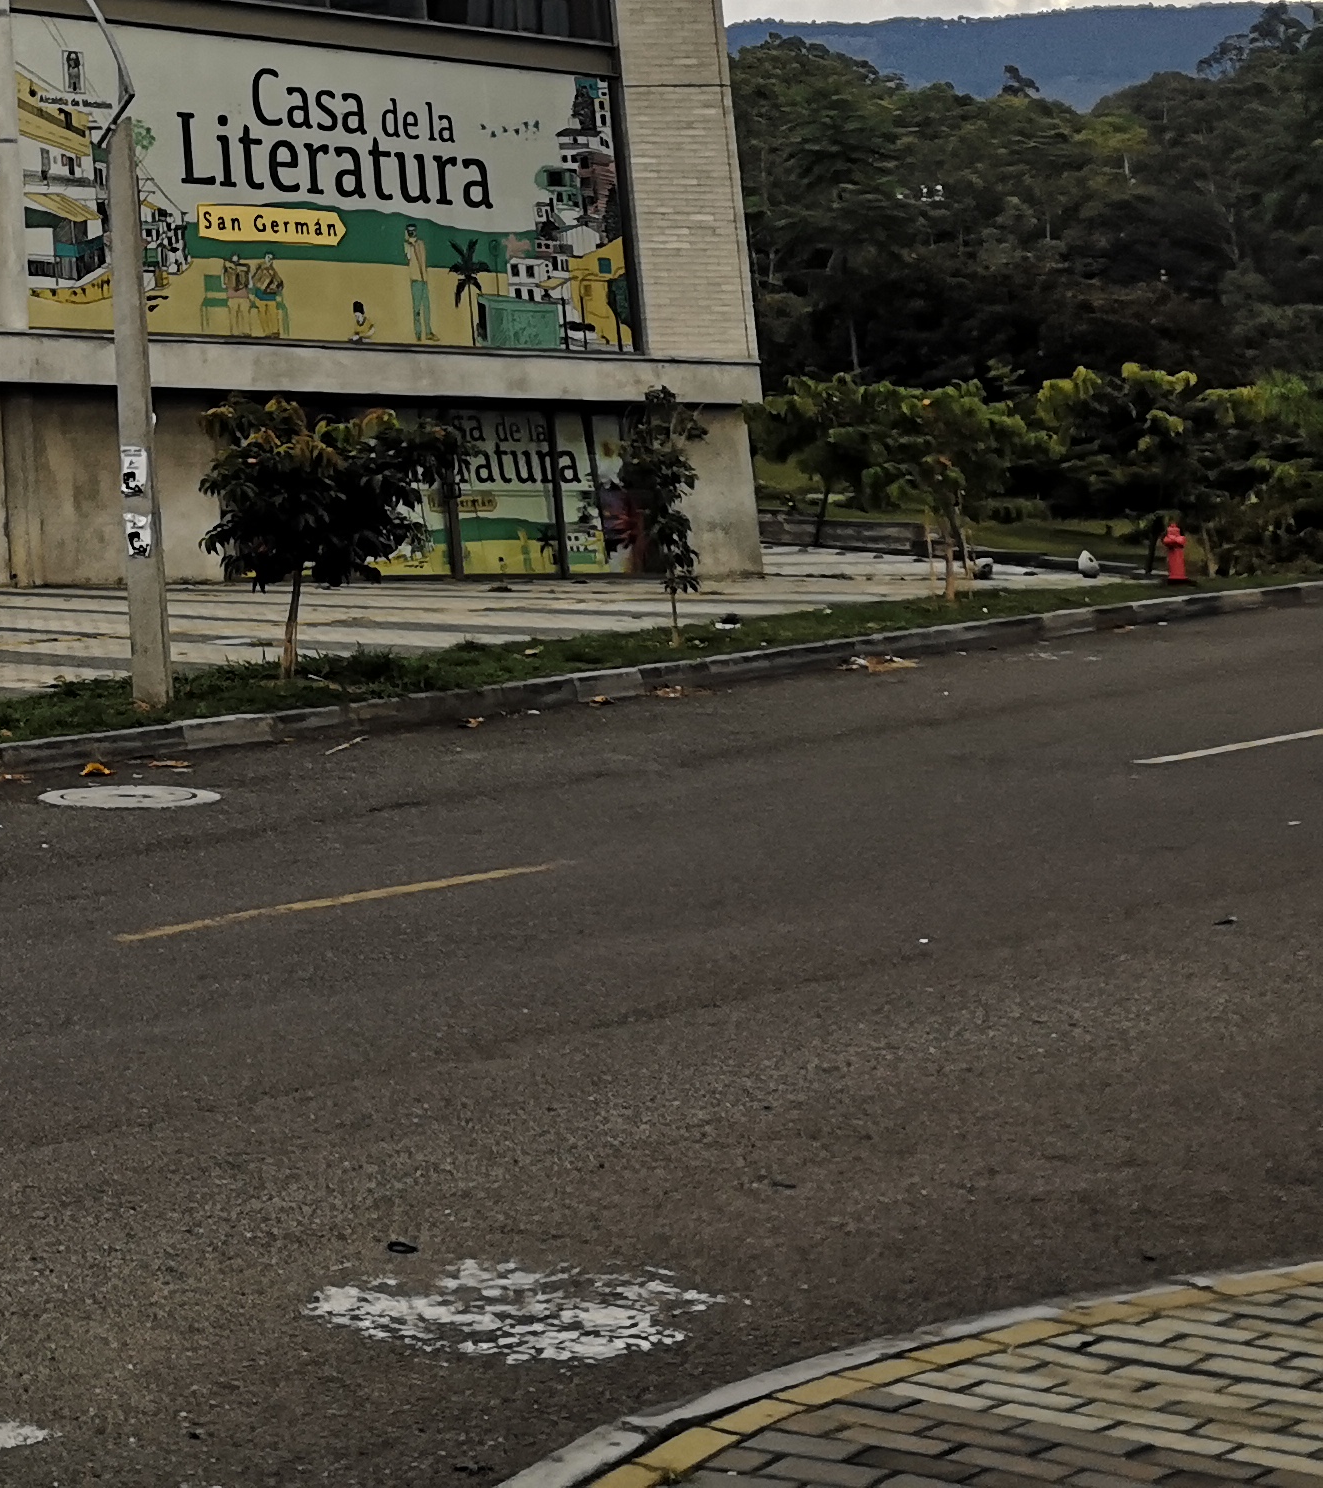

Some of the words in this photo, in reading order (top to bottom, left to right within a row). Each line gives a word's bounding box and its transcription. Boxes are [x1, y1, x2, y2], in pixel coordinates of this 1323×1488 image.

[251, 67, 368, 136] Casa
[381, 97, 420, 140] de
[425, 101, 456, 144] la
[176, 111, 494, 209] Literatura
[203, 210, 242, 232] San
[253, 214, 338, 237] Germán
[494, 416, 522, 443] de
[527, 417, 549, 443] la
